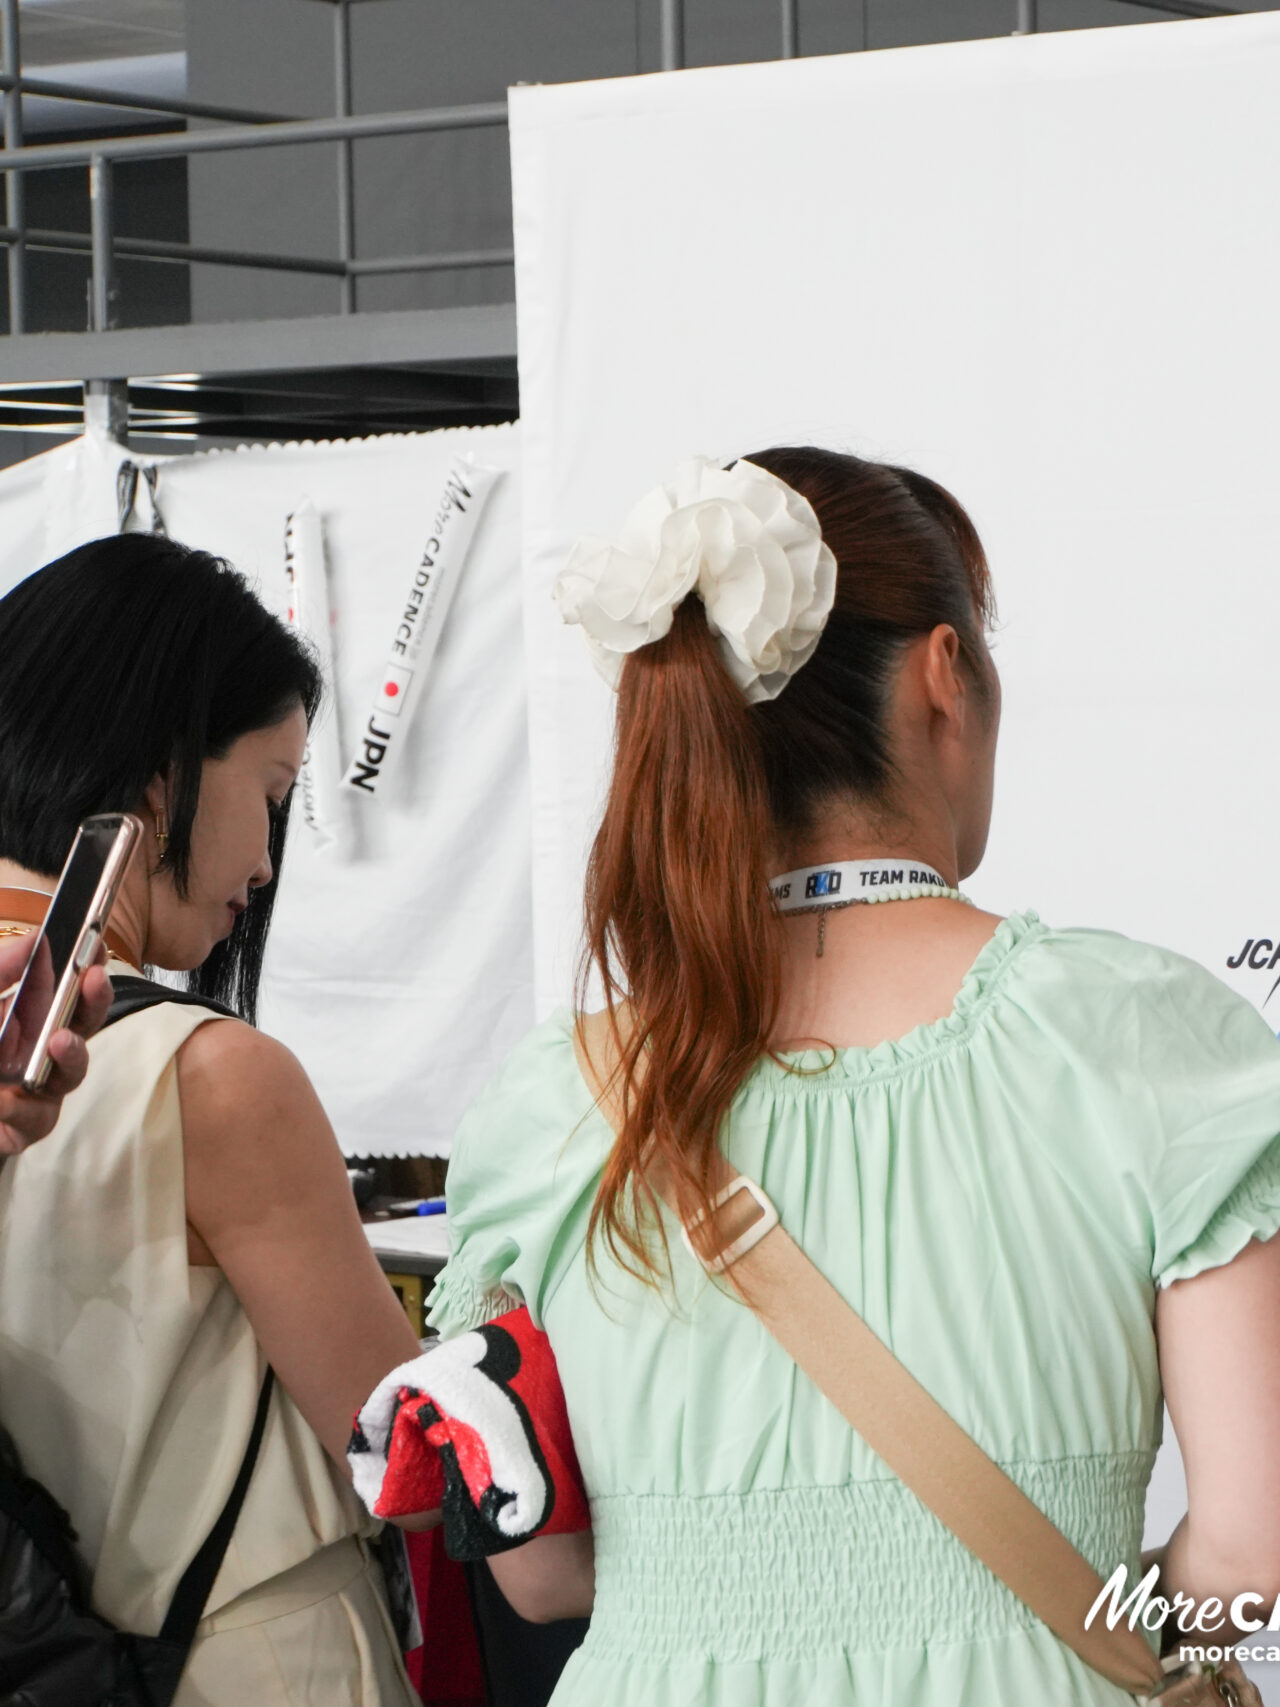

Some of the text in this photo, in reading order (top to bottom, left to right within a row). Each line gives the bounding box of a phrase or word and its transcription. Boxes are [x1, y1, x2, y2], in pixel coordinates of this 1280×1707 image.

[351, 715, 392, 793] JPN
[859, 869, 904, 887] TEAM
[909, 870, 947, 888] RAKU
